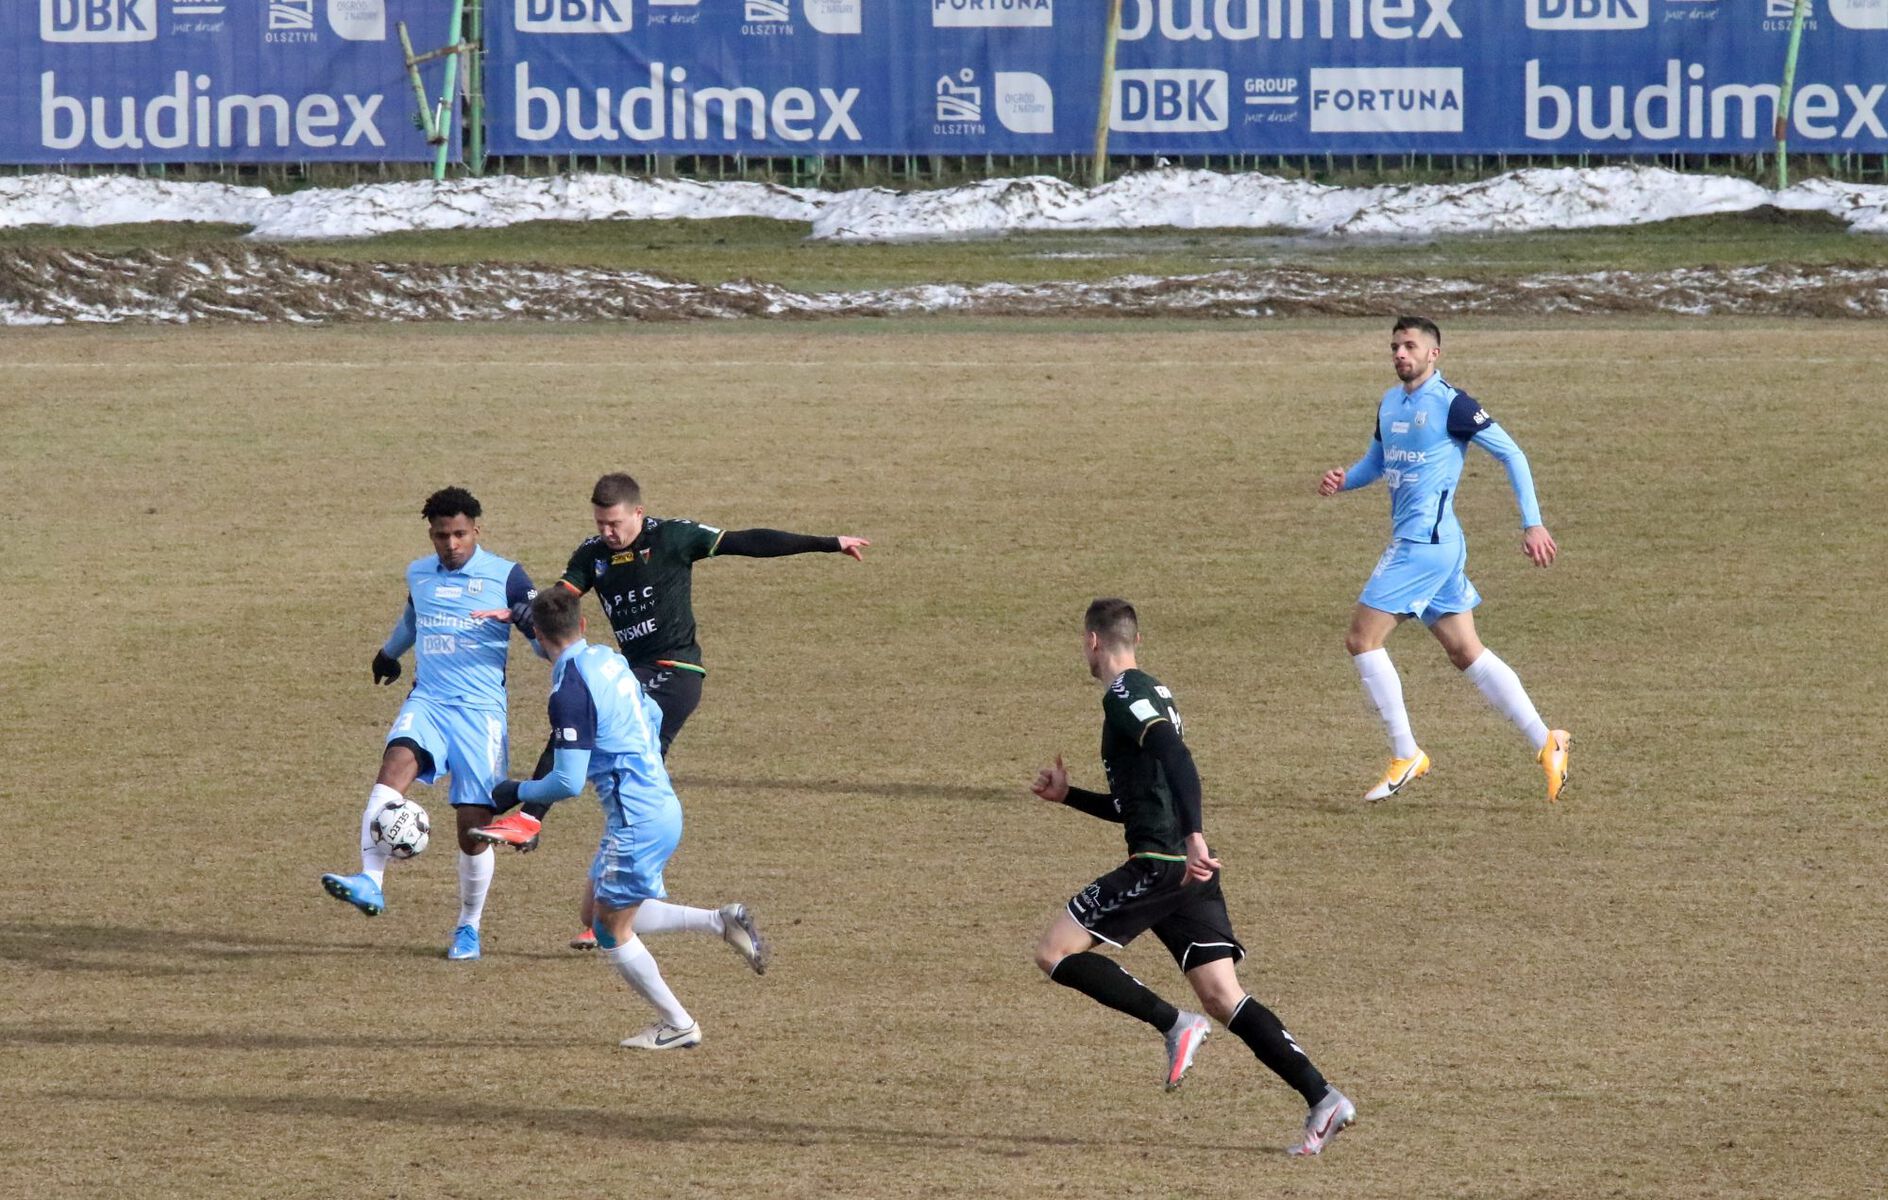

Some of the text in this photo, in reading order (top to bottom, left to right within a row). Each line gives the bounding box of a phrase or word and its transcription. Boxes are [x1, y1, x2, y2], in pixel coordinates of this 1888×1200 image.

[52, 0, 147, 32] DBK
[1762, 20, 1817, 31] OLSZYN
[265, 32, 318, 43] OLSZTYN
[741, 24, 794, 36] OLSZTYN
[1244, 77, 1298, 92] GROUP
[41, 70, 386, 149] budimex
[515, 61, 863, 141] budimex
[1121, 79, 1219, 121] DBK
[1313, 89, 1460, 111] FORTUNA
[1525, 59, 1888, 140] budimex
[933, 124, 986, 135] OLSZTYN
[614, 586, 653, 606] PEC
[387, 811, 410, 840] SELECT
